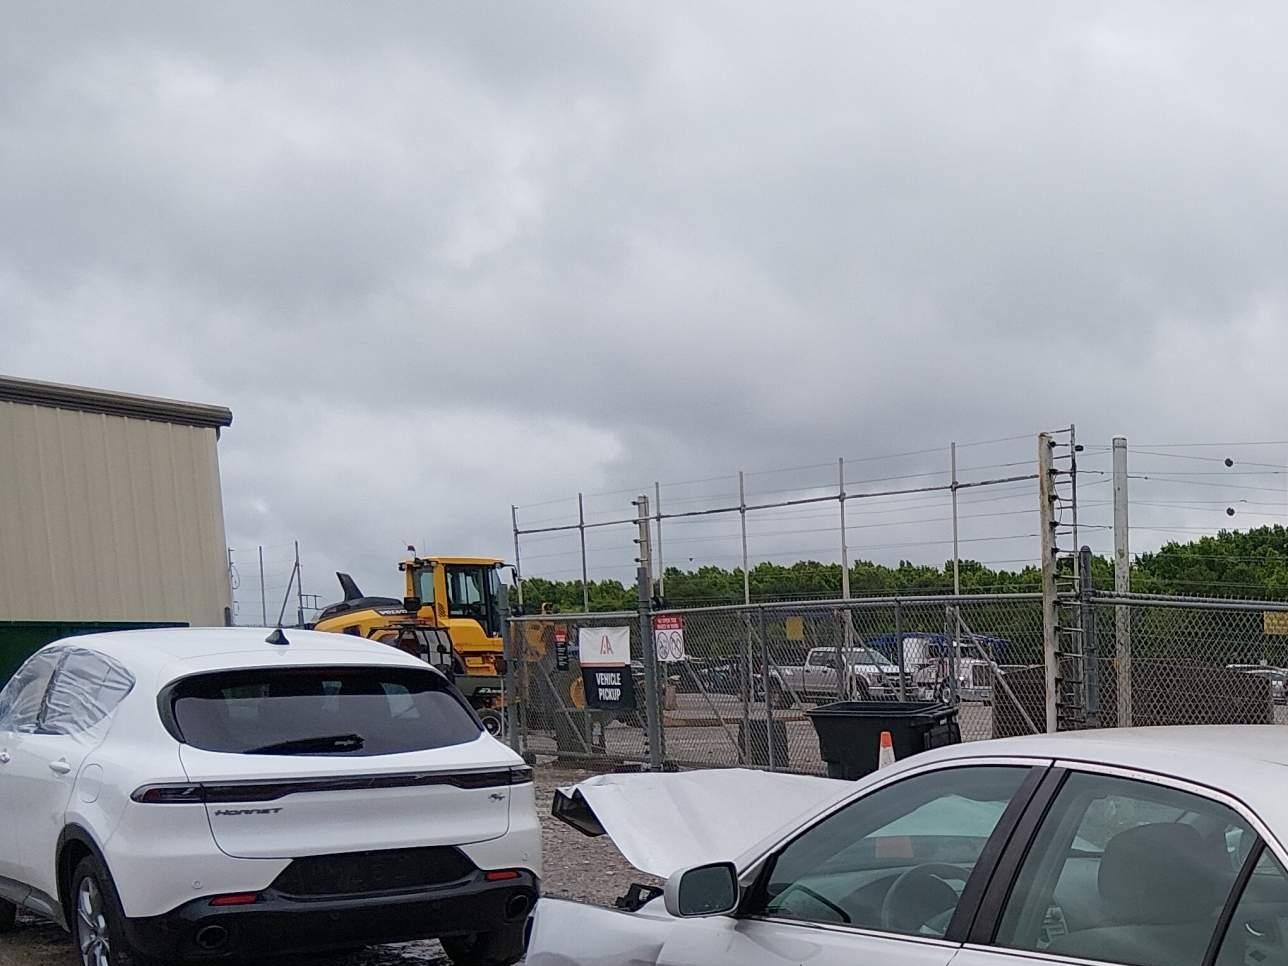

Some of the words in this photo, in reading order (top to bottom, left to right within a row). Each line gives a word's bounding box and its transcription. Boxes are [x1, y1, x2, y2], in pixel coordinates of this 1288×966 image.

[595, 672, 622, 686] VEHICLE
[598, 687, 621, 701] PICKUP
[215, 807, 283, 816] HORNET
